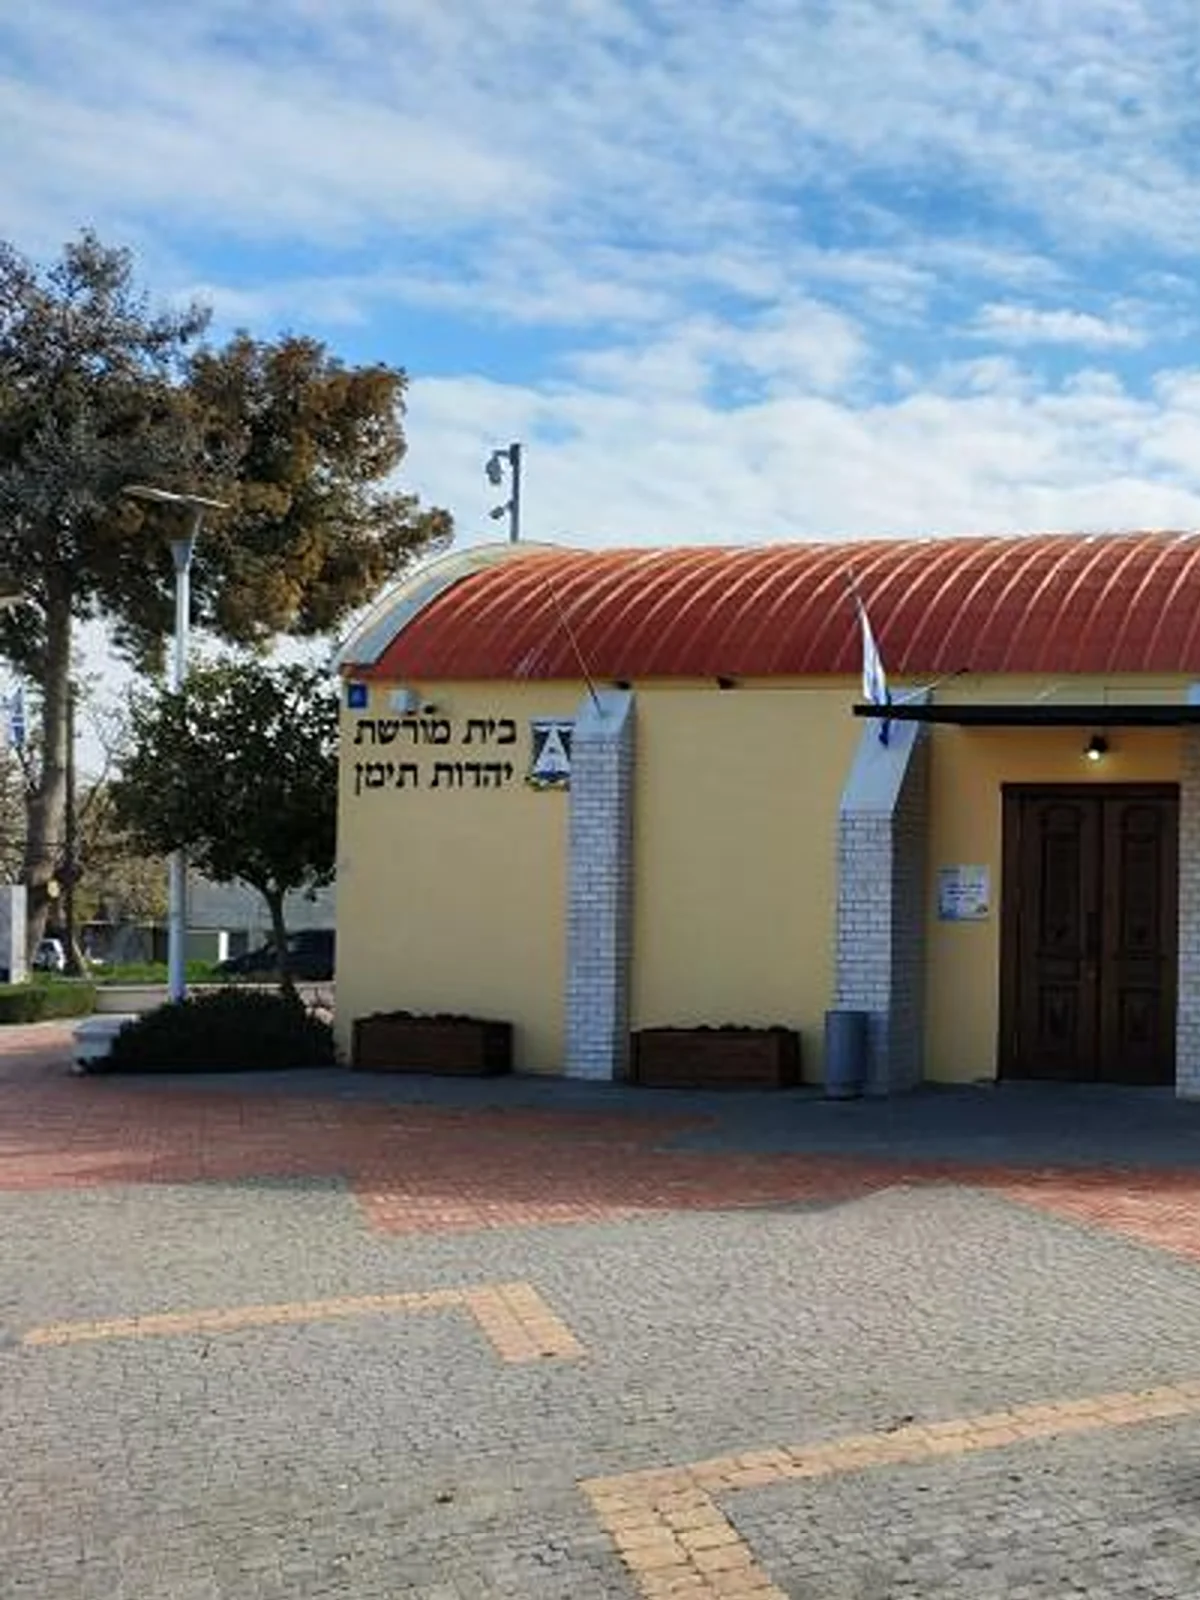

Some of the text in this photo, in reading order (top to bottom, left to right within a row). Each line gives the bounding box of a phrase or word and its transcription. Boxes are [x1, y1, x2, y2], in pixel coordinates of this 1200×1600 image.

[354, 718, 517, 745] בית מורשת
[355, 762, 514, 796] יהדות תימן
